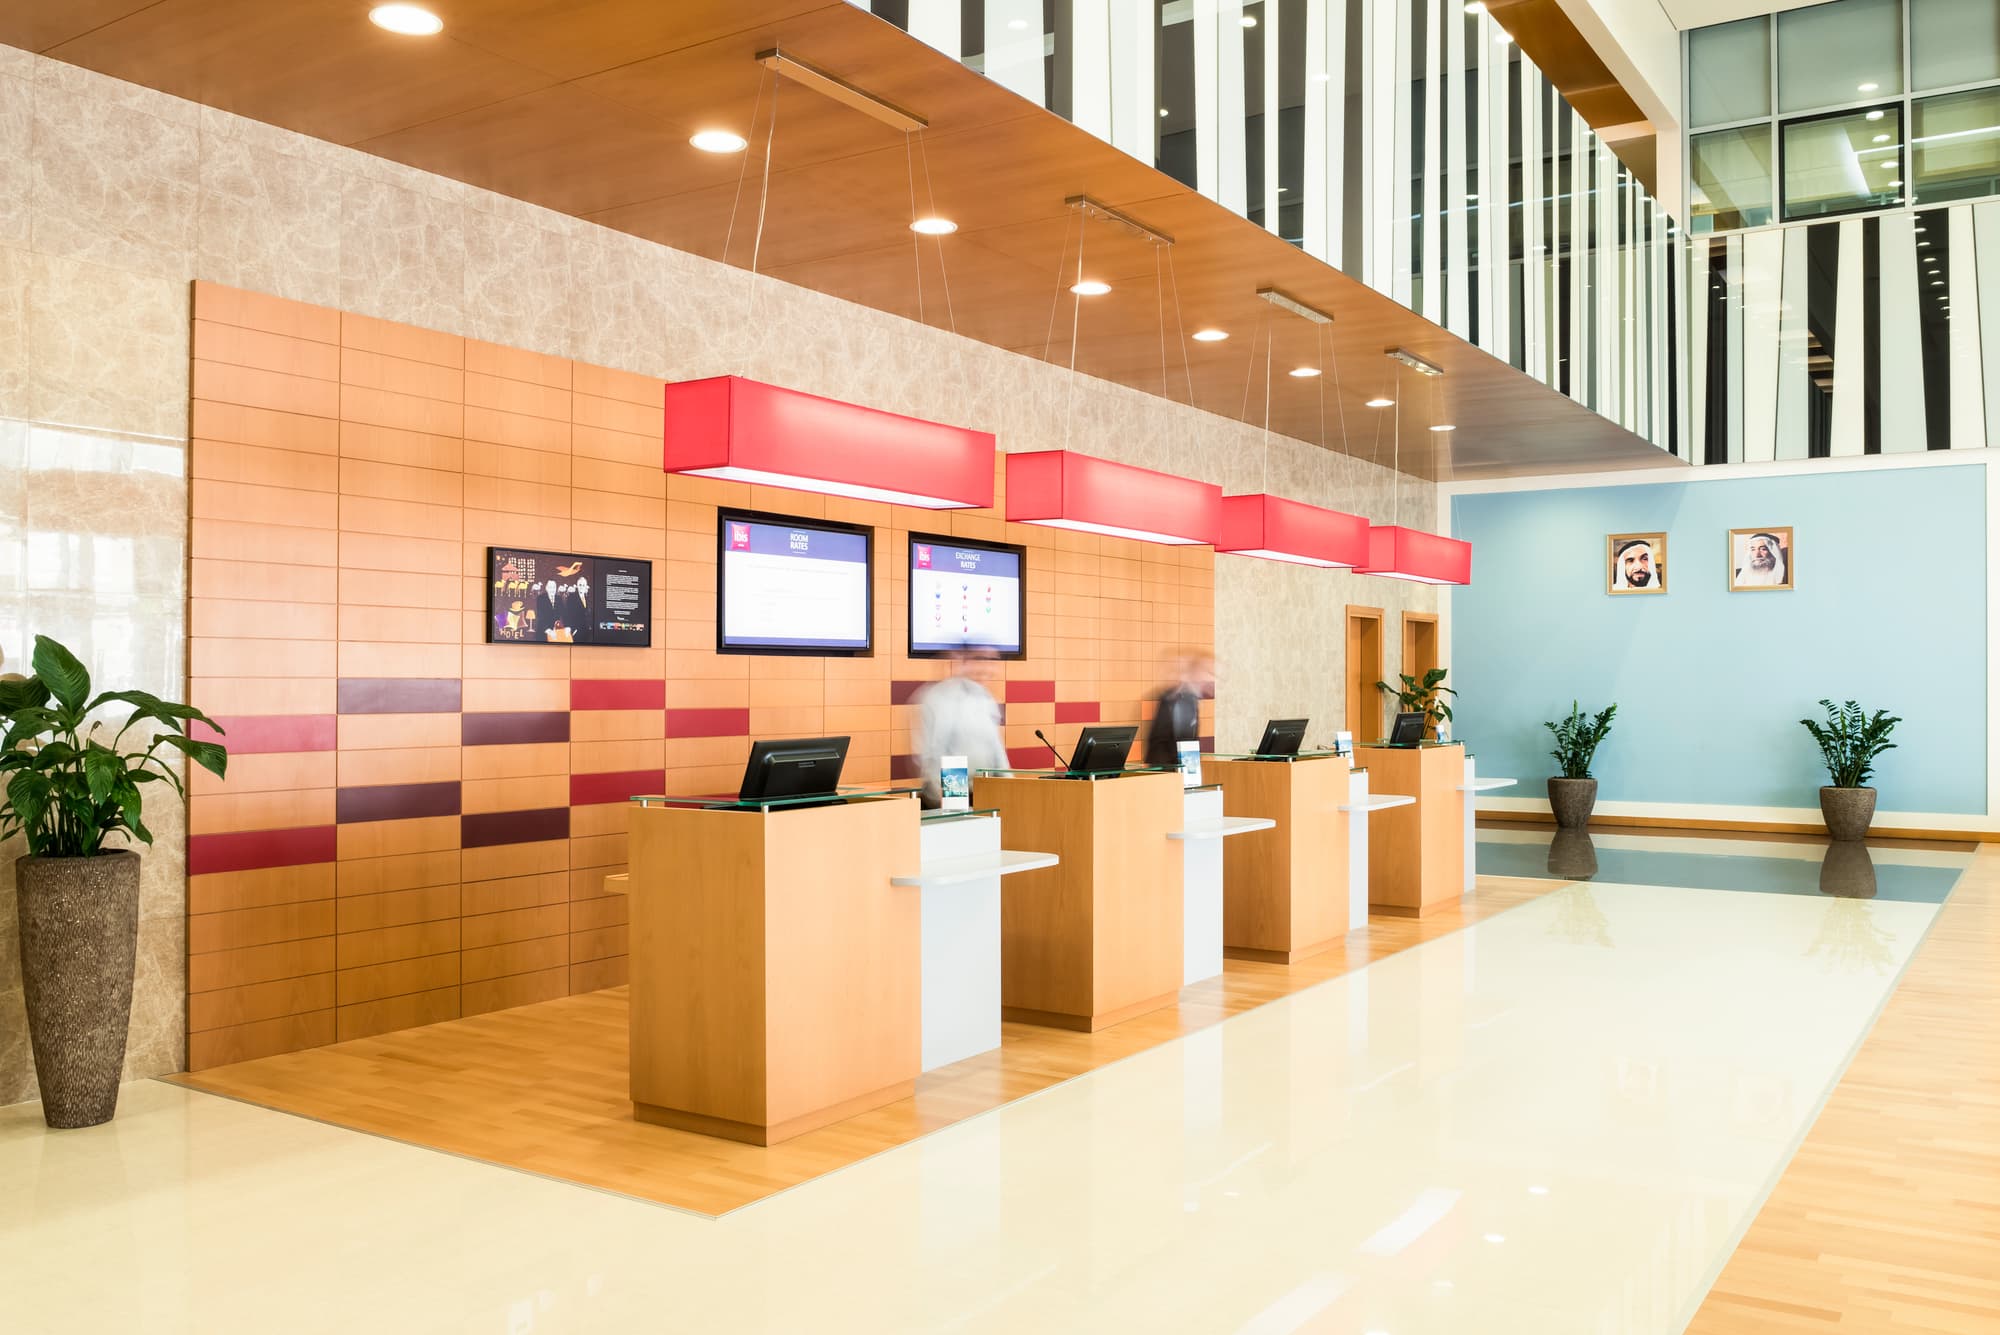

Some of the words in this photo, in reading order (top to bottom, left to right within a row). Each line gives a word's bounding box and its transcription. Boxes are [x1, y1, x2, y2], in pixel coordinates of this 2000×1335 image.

[734, 530, 748, 542] ibis
[790, 533, 808, 542] ROOM
[790, 541, 808, 550] RATES
[955, 552, 980, 561] EXCHANGE
[960, 561, 976, 569] RATES
[500, 628, 524, 639] HOTEL
